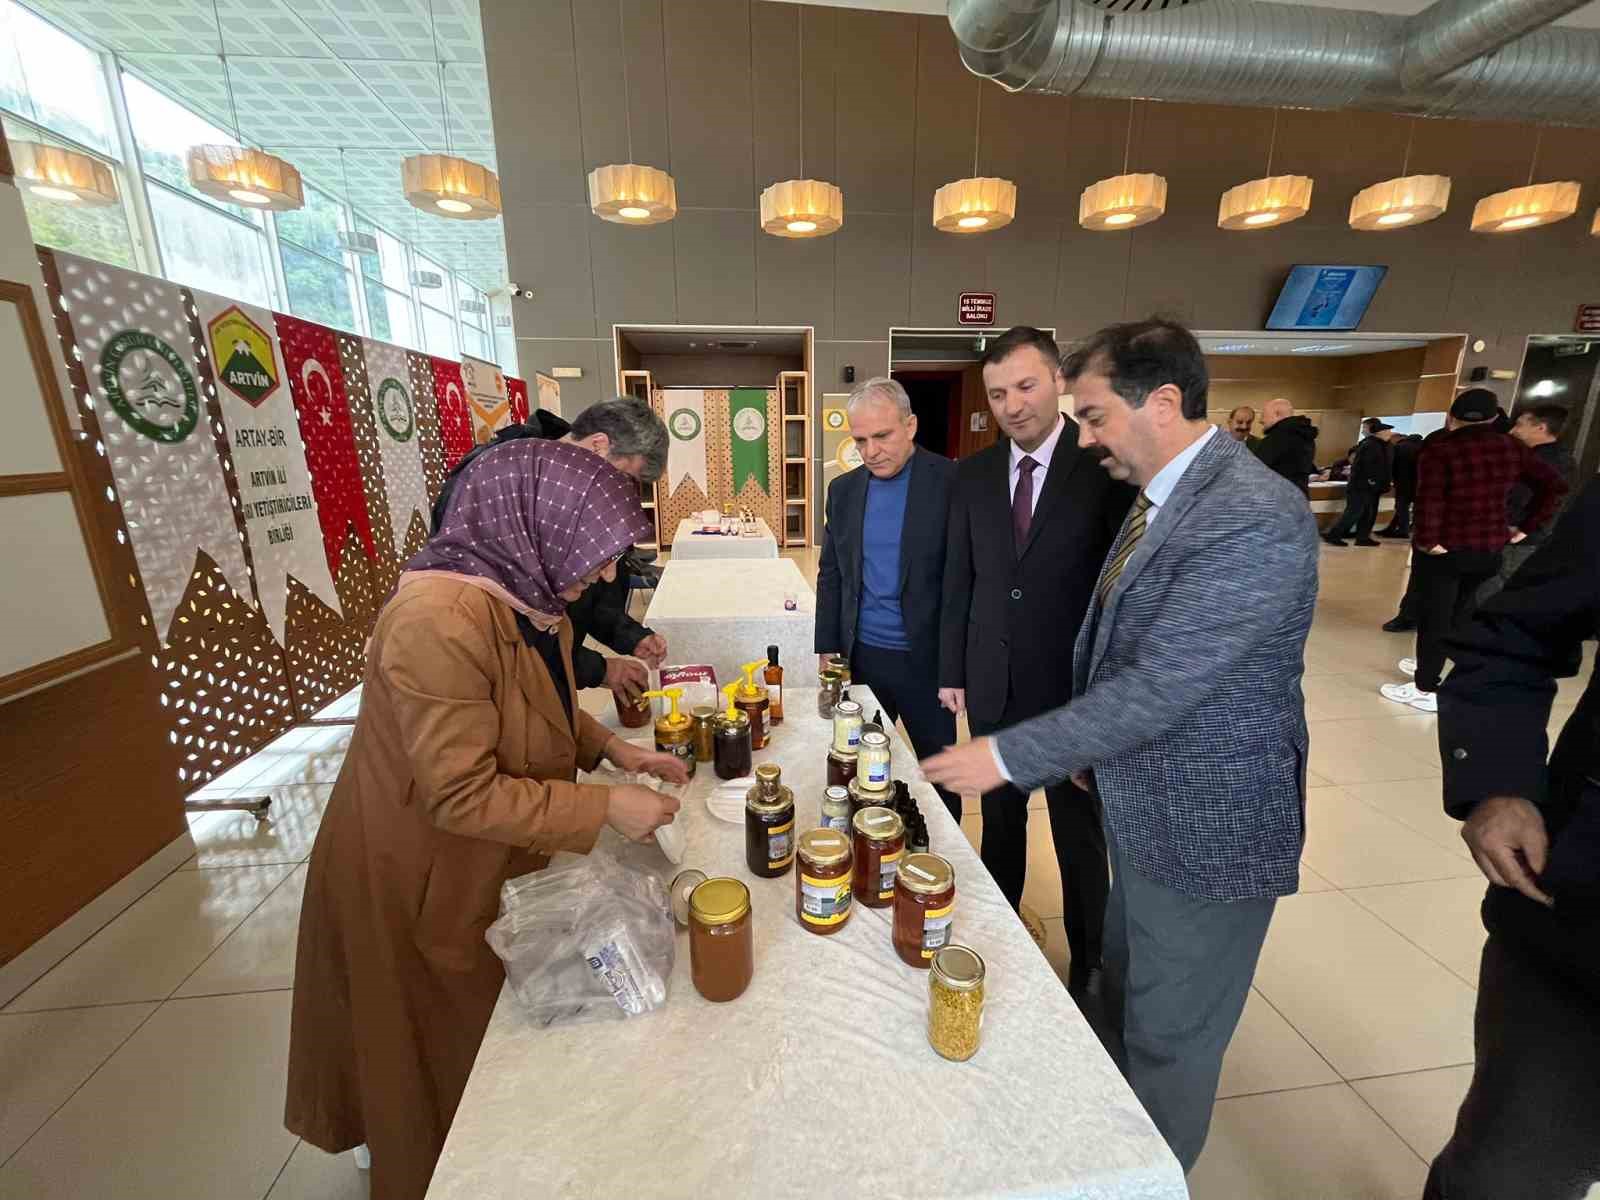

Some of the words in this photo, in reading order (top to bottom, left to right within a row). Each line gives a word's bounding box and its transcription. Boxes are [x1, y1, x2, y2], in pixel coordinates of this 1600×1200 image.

[229, 370, 270, 388] ARTVİN
[235, 426, 288, 448] ARTAY-BİR
[250, 467, 277, 488] ARTVİN
